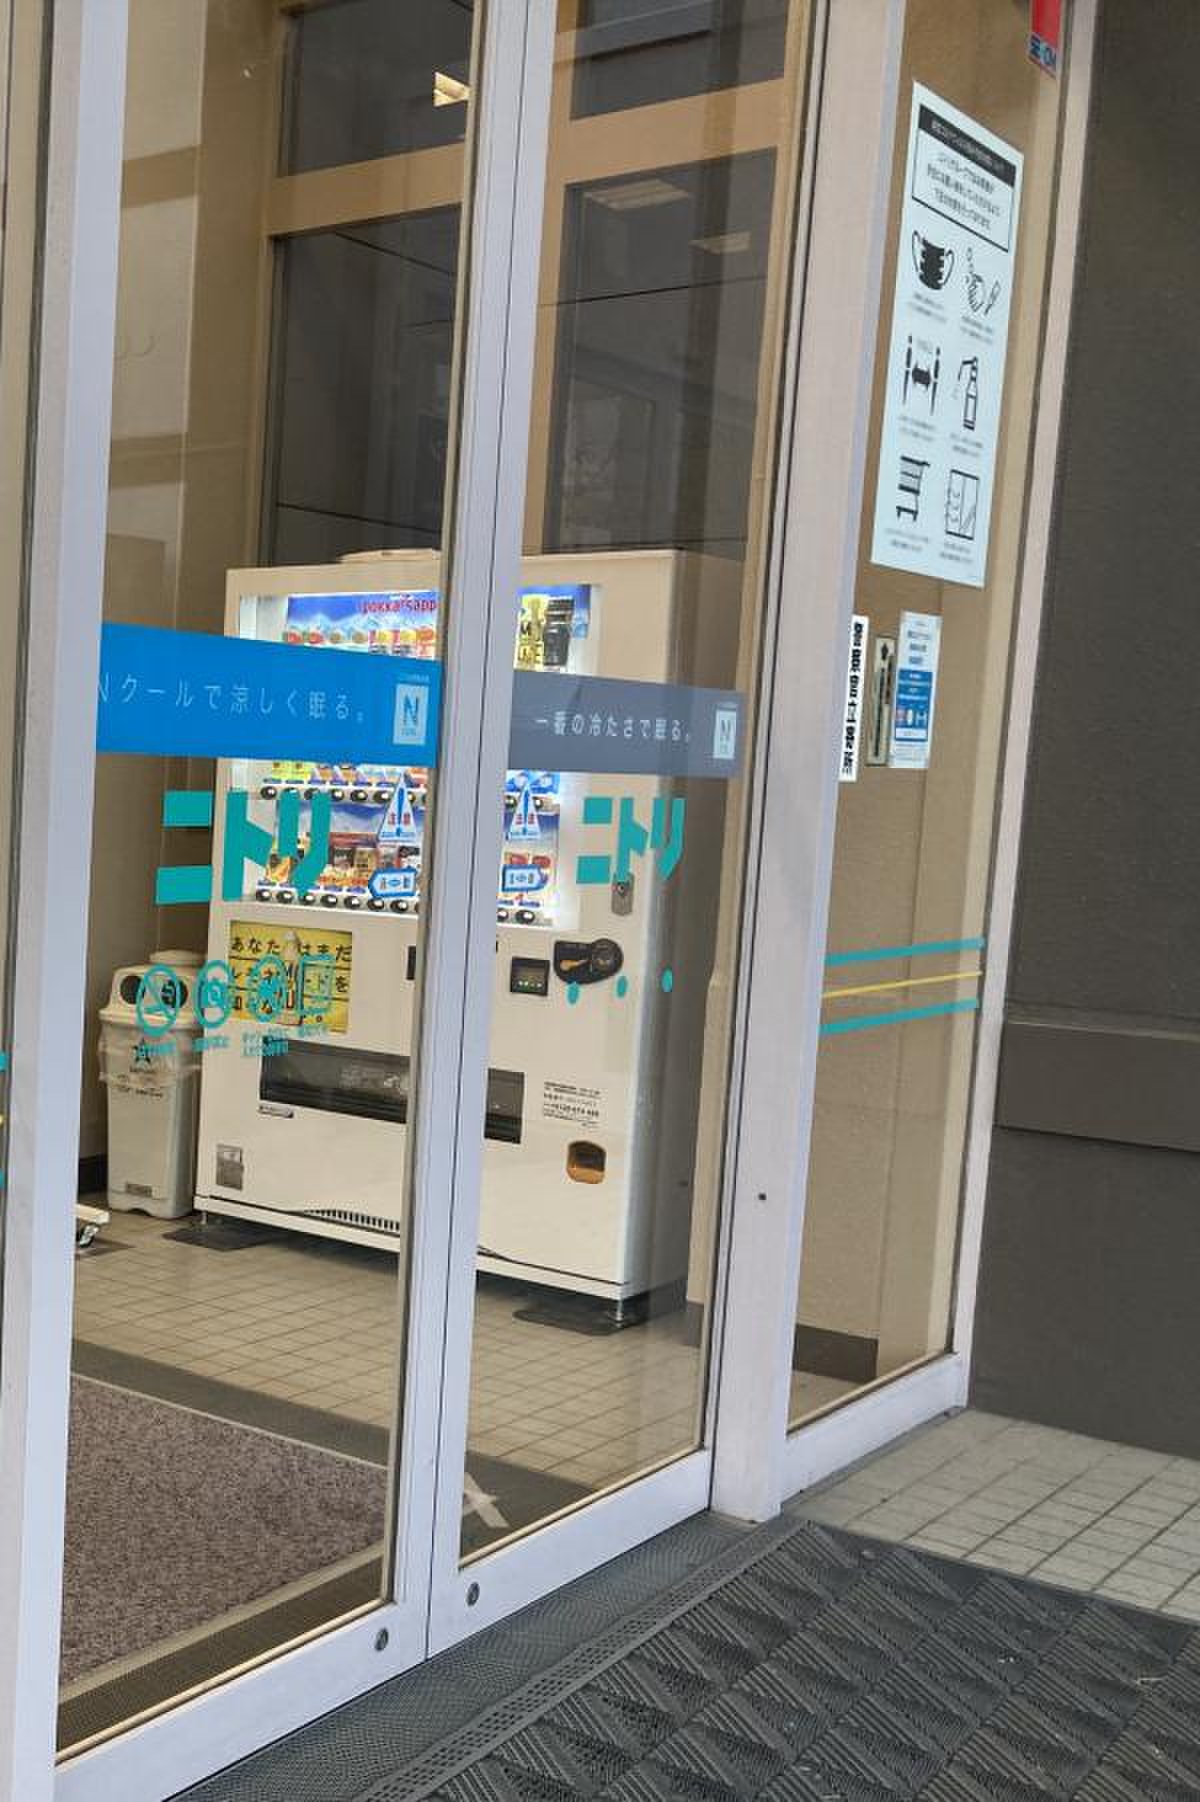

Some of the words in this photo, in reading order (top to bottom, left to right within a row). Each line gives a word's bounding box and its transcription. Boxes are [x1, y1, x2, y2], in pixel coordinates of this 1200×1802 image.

[155, 790, 333, 905] ニトリ
[576, 797, 686, 884] ニトリ
